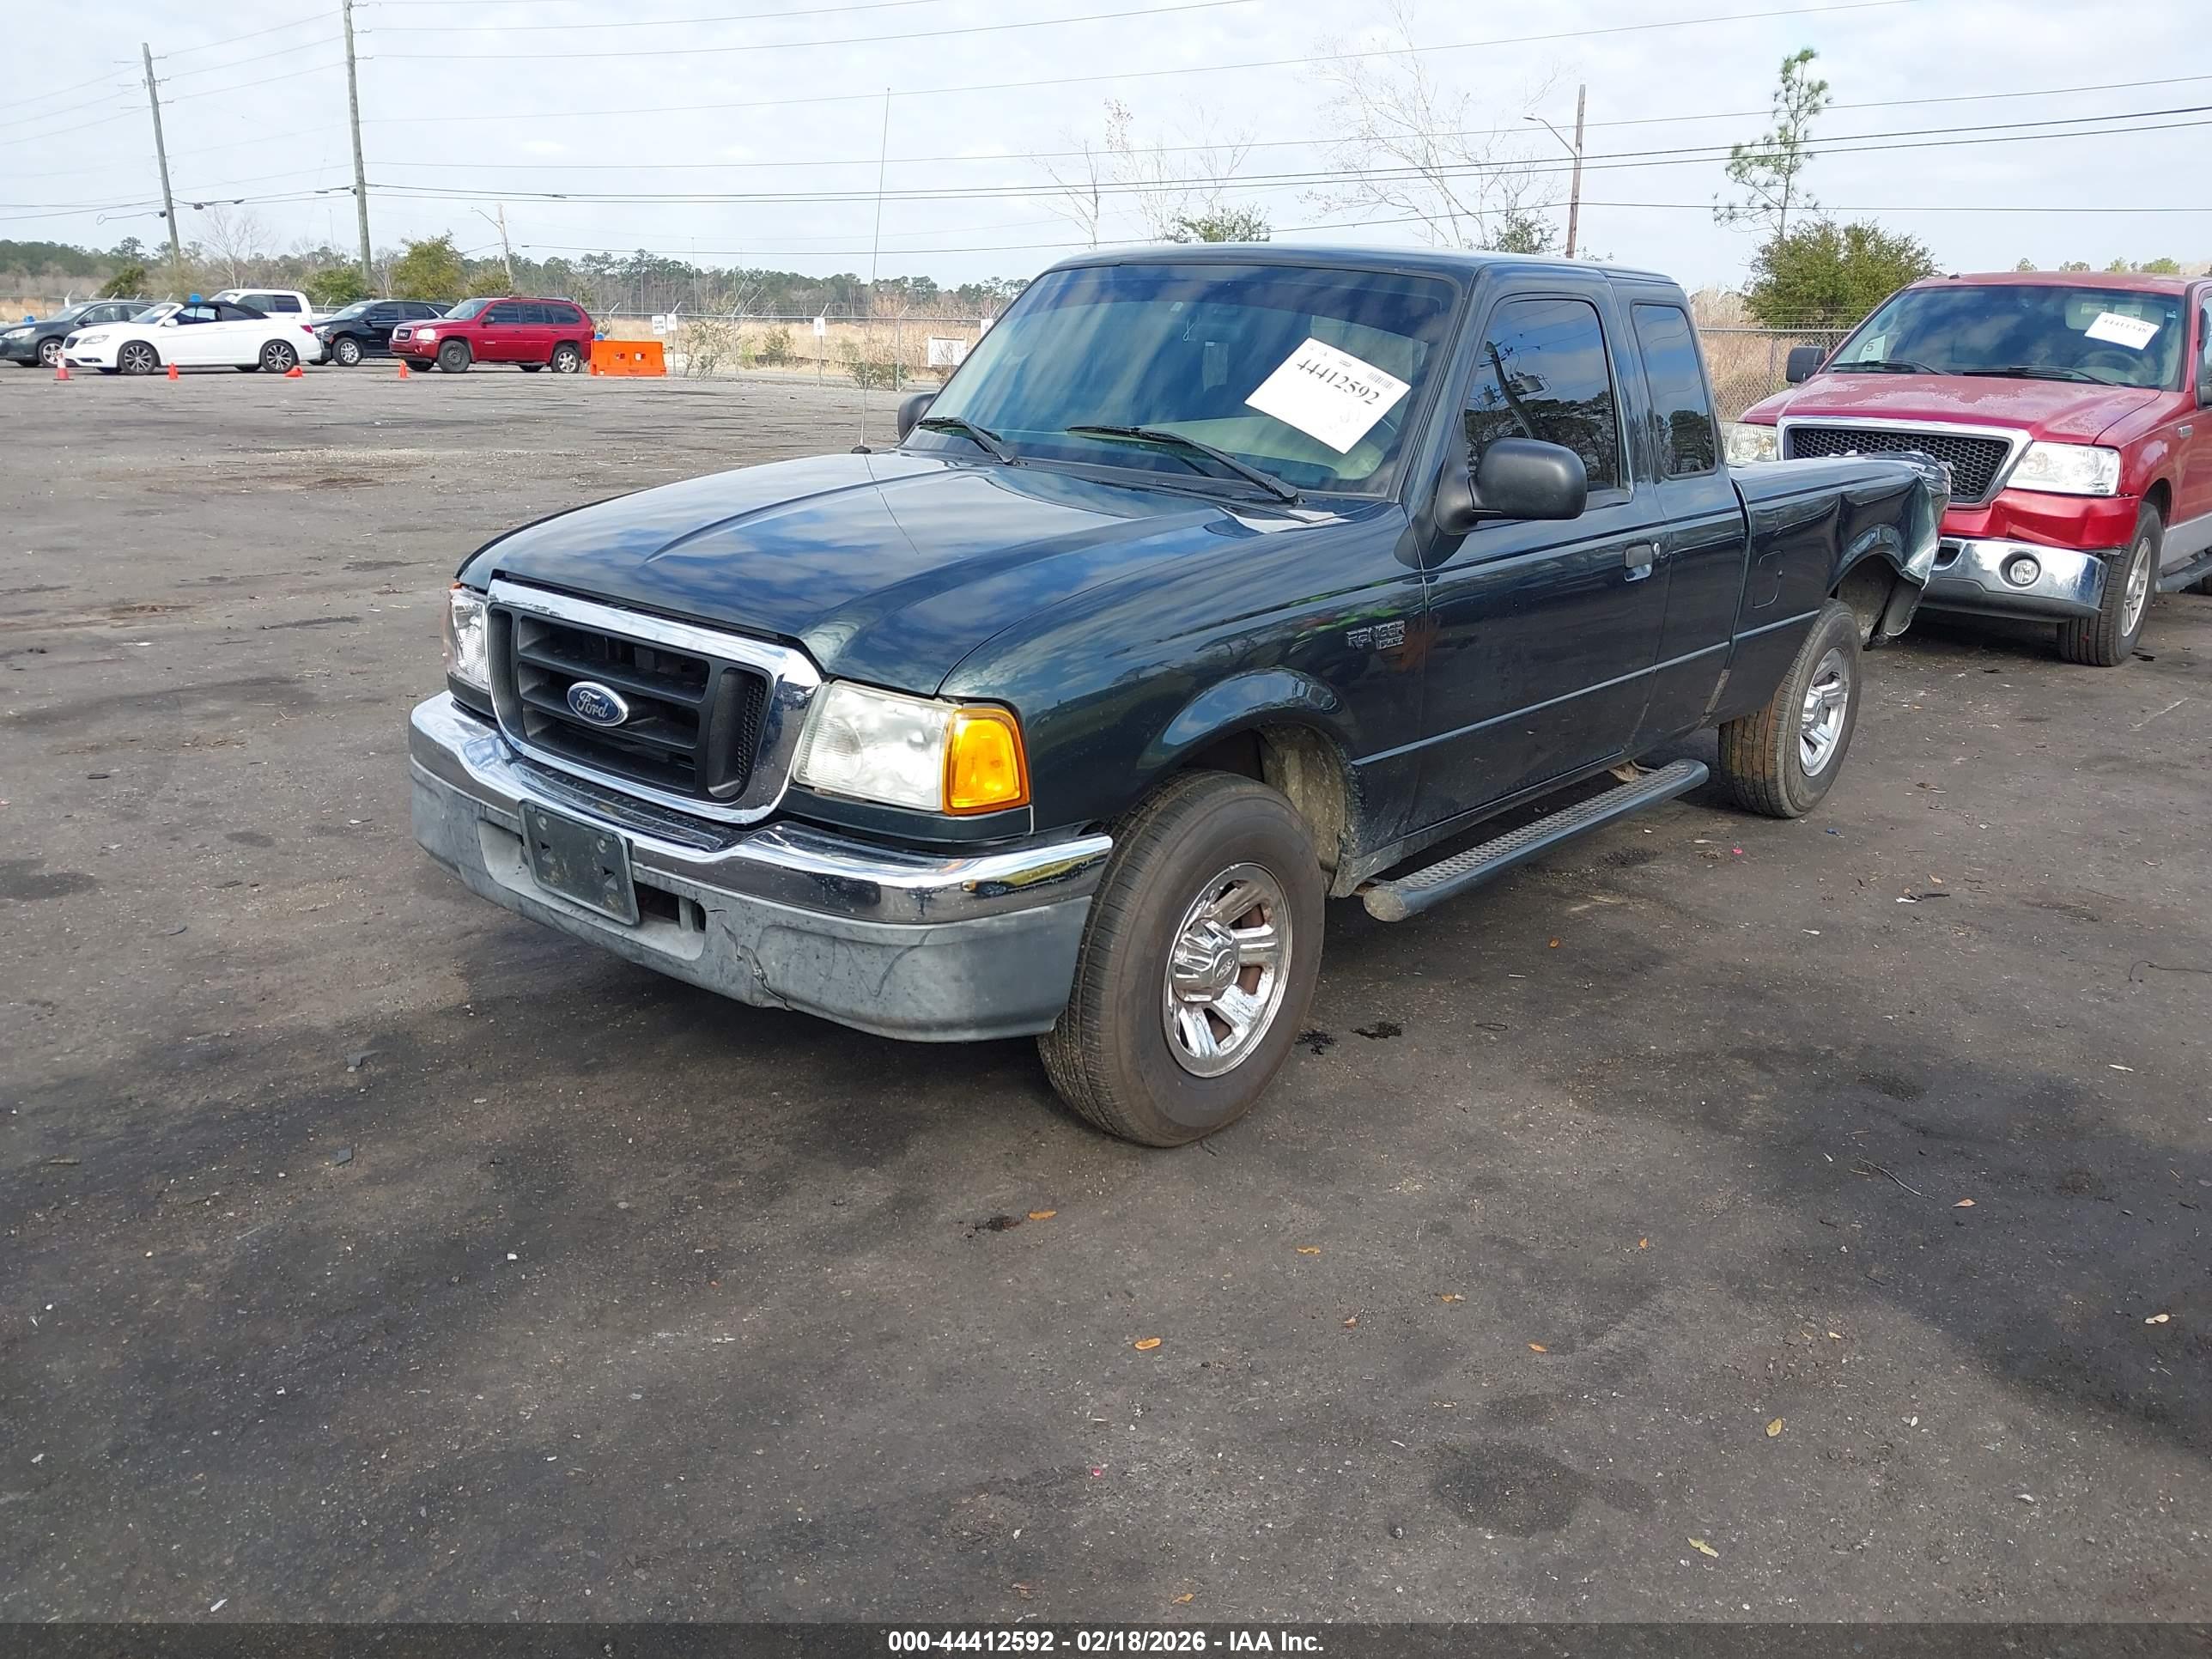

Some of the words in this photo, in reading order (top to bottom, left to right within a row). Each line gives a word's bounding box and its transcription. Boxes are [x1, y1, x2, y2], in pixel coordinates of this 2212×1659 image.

[1866, 342, 1875, 352] 5
[1297, 358, 1380, 405] 44412592
[576, 690, 609, 719] Ford
